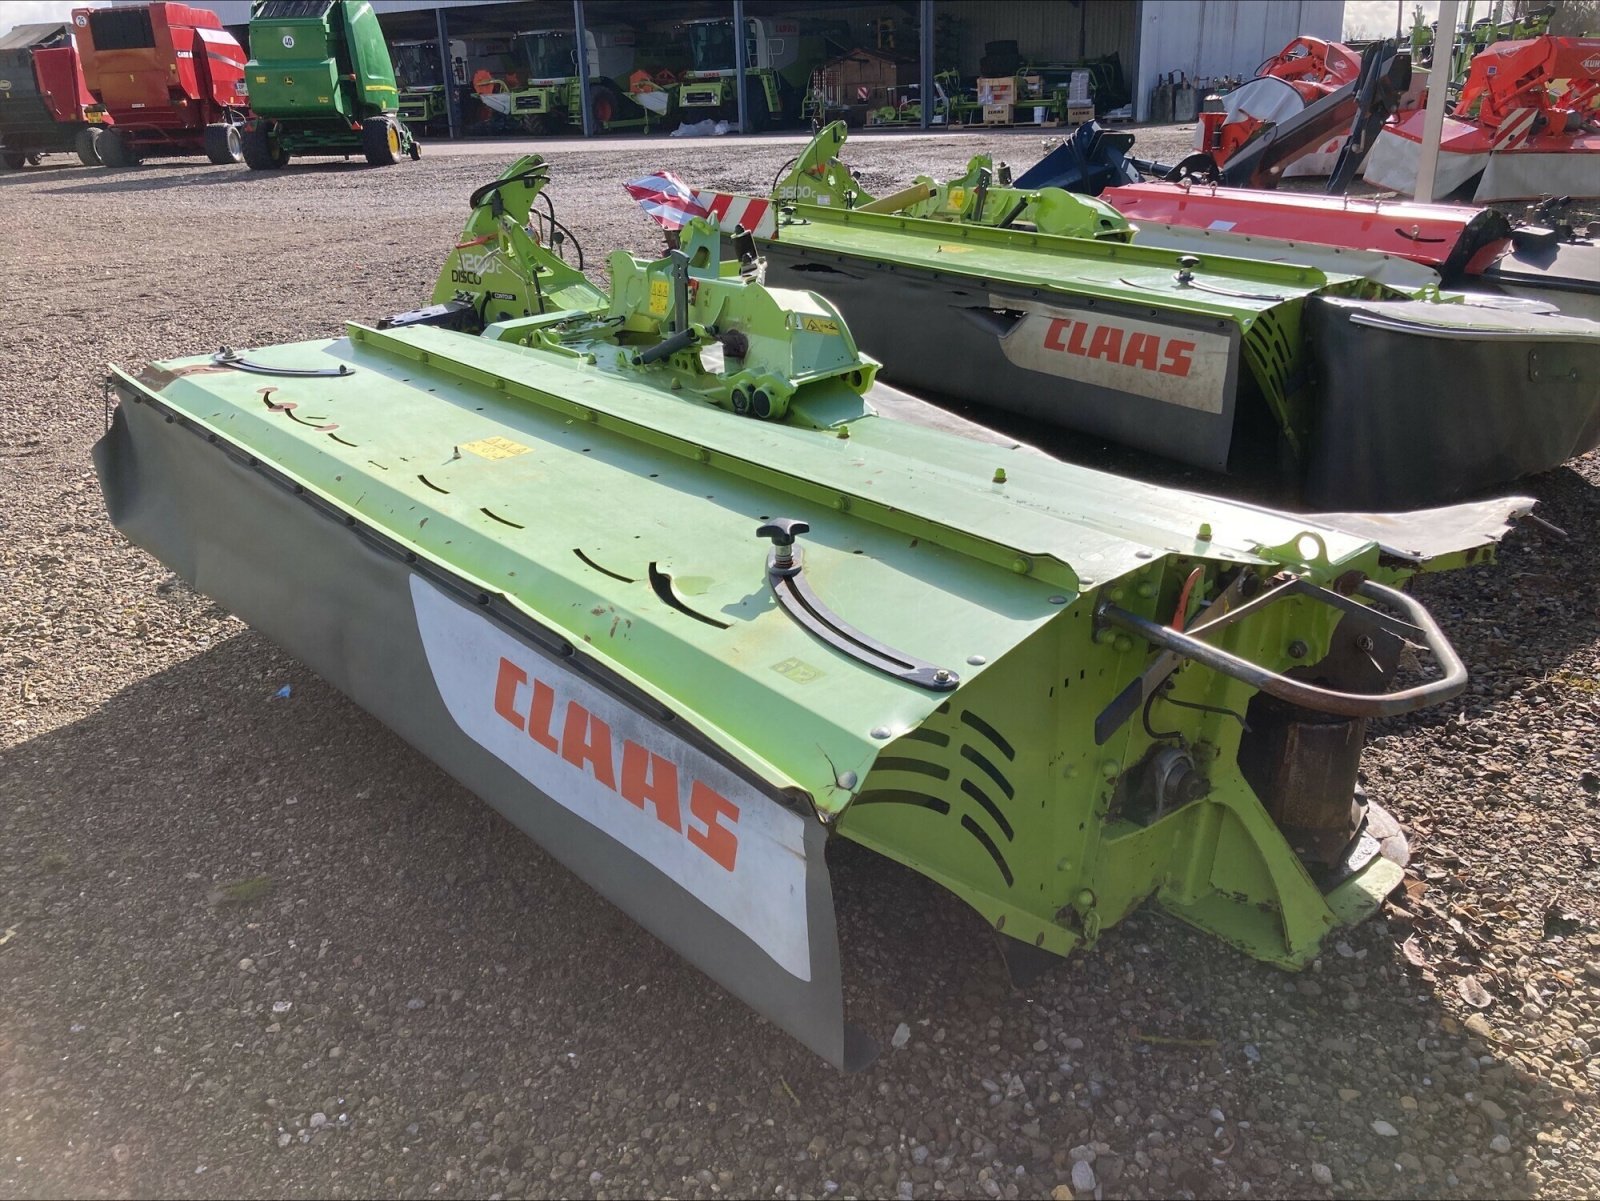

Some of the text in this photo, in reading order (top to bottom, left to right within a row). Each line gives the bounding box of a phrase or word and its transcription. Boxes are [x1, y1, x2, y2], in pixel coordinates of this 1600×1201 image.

[284, 36, 293, 46] 40
[452, 270, 481, 285] DISCO
[1043, 317, 1197, 377] CLAAS
[494, 656, 740, 872] CLAAS
